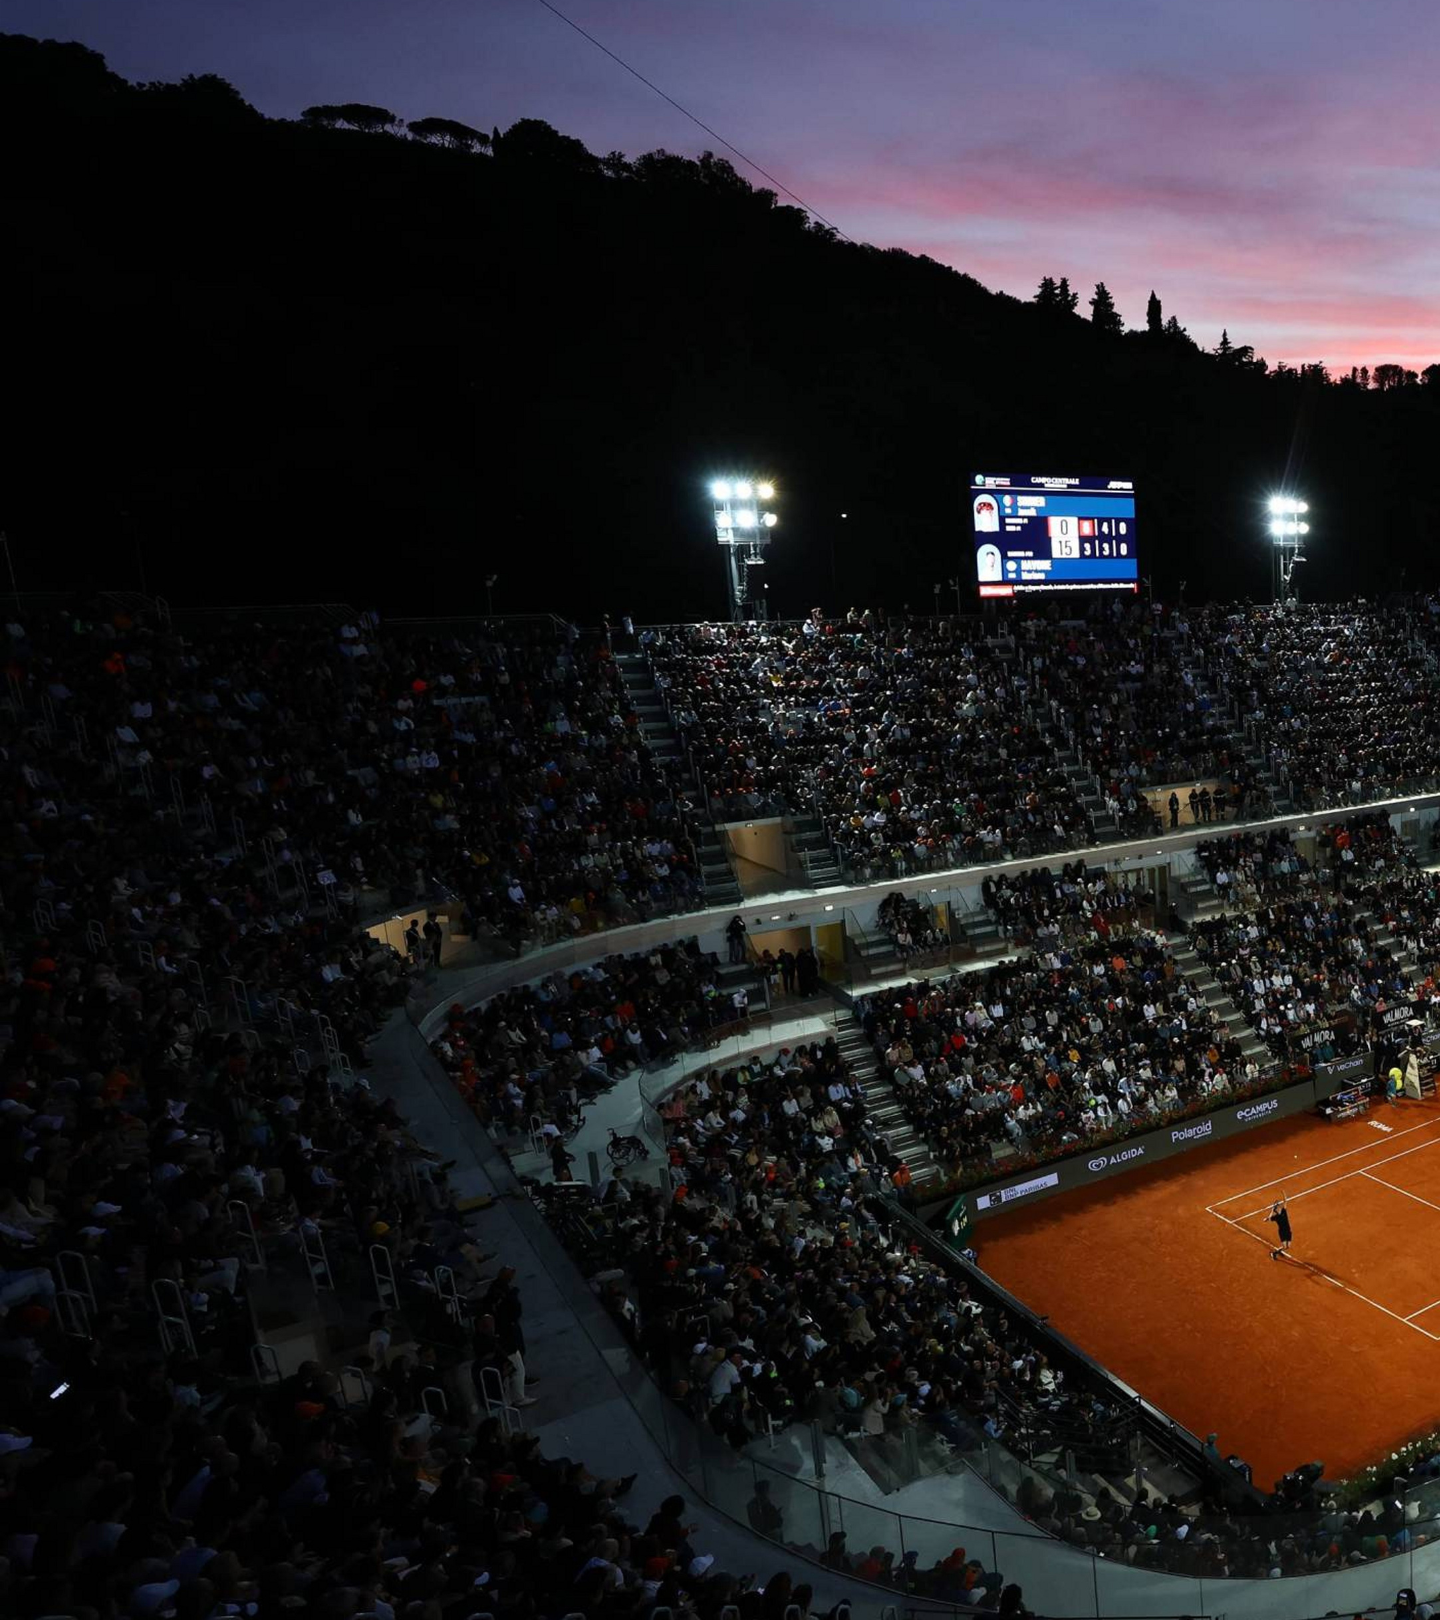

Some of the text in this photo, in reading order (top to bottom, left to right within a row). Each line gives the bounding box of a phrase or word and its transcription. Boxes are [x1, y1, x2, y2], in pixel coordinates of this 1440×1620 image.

[1060, 519, 1068, 535] 0
[1101, 521, 1109, 534] 4
[1058, 540, 1128, 556] 15 3 3 0
[1383, 1006, 1414, 1024] VALMORA
[1336, 1059, 1364, 1072] VeChain
[1236, 1100, 1279, 1120] eCAMPUS
[1171, 1120, 1212, 1143] Polaroid
[1367, 1120, 1394, 1133] ROMA
[1109, 1147, 1145, 1165] ALGIDA
